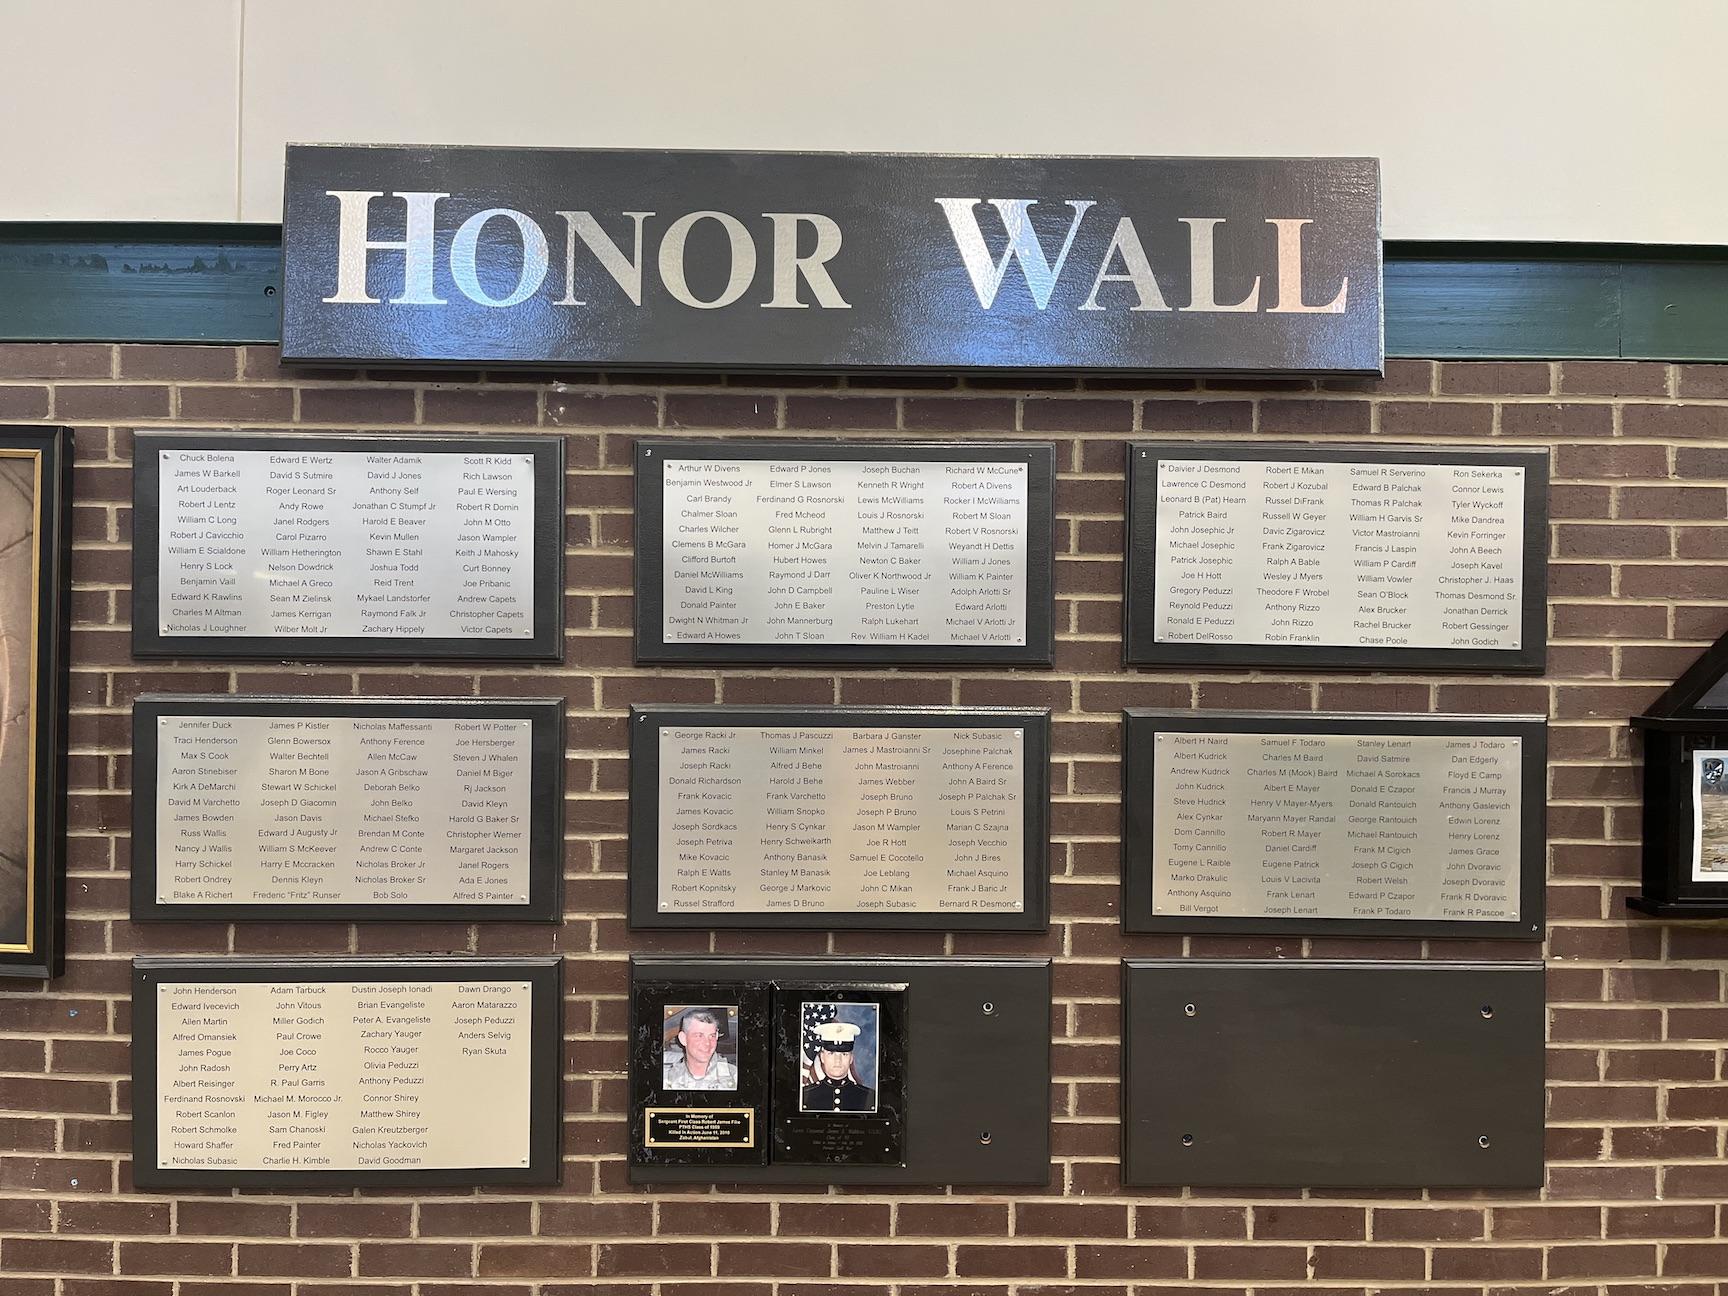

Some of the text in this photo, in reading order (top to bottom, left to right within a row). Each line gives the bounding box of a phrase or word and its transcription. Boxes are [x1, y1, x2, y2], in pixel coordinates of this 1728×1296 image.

[321, 190, 1351, 315] HONOR WALL
[861, 466, 920, 475] Joseph Buchan
[463, 472, 513, 481] Rich Lawson
[899, 481, 924, 491] Wright
[1452, 485, 1504, 494] Connor Lewis
[686, 494, 732, 505] Carl Brandy
[278, 502, 300, 512] Andy
[1179, 510, 1205, 518] Patrick
[296, 518, 330, 527] Rodgers
[678, 525, 739, 533] Charles Wilcher
[369, 532, 392, 541] Kevin
[773, 556, 827, 564] Hubert Howes
[399, 564, 419, 572] Todd
[1169, 602, 1201, 610] Reynold
[1377, 606, 1407, 614] Brucker
[1292, 618, 1314, 626] Rizzo
[362, 625, 394, 634] Zachary
[1289, 634, 1320, 642] Franklin
[359, 737, 425, 747] Anthony Ference
[1262, 753, 1292, 762] Charles
[268, 768, 297, 776] Sharon
[1448, 771, 1469, 780] Floyd
[1471, 771, 1477, 779] E
[858, 777, 884, 786] James
[1263, 784, 1286, 792] Albert
[1296, 784, 1320, 794] Mayer
[860, 793, 889, 802] Joseph
[485, 800, 508, 809] Kleyn
[300, 814, 322, 822] Davis
[948, 839, 976, 848] Joseph
[450, 846, 485, 855] Margaret
[1448, 848, 1500, 856] James Grace
[175, 860, 232, 870] Harry Schickel
[202, 876, 232, 885] Ondrey
[1263, 904, 1292, 914] Joseph
[482, 986, 512, 994] Drango
[206, 1048, 232, 1058] Pogue
[462, 1048, 483, 1056] Ryan
[278, 1064, 300, 1073] Perry
[176, 1110, 236, 1118] Robert Scanlon
